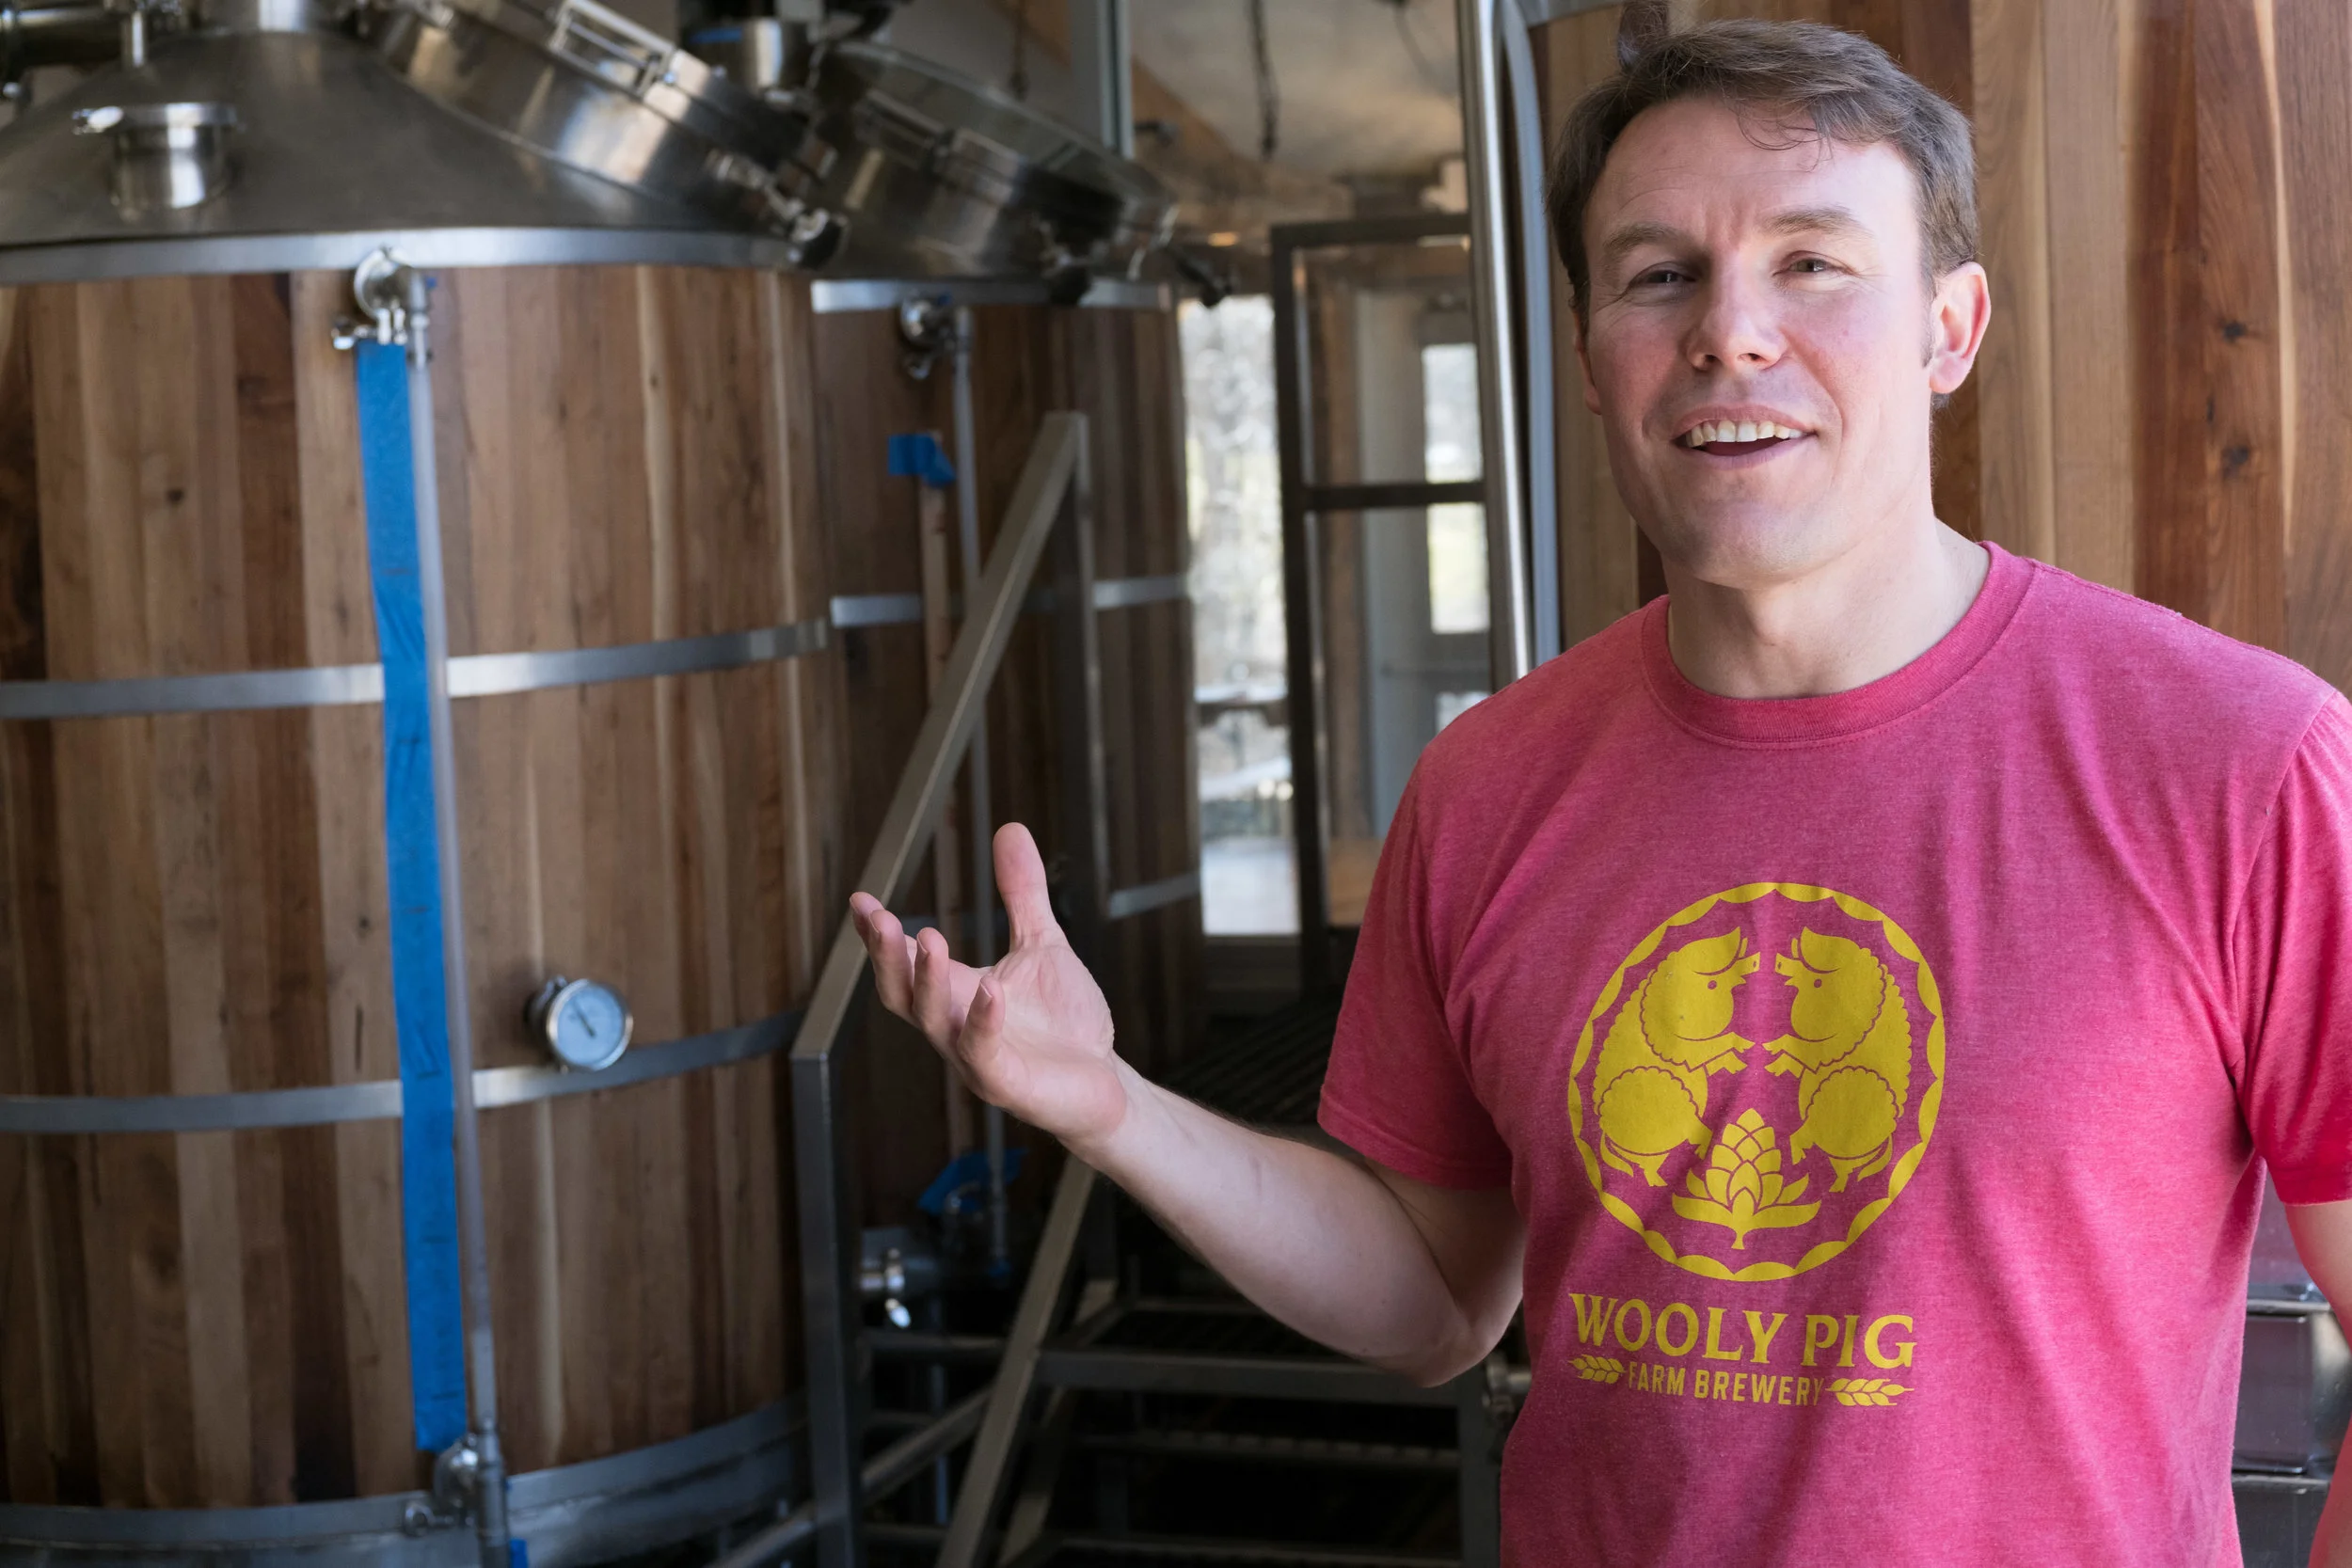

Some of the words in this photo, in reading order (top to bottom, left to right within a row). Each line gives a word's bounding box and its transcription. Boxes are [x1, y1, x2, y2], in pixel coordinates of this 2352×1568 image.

[1568, 1292, 1788, 1364] WOOLY
[1801, 1314, 1917, 1369] PIG
[1629, 1361, 1685, 1397] FARM
[1694, 1370, 1825, 1406] BREWERY
